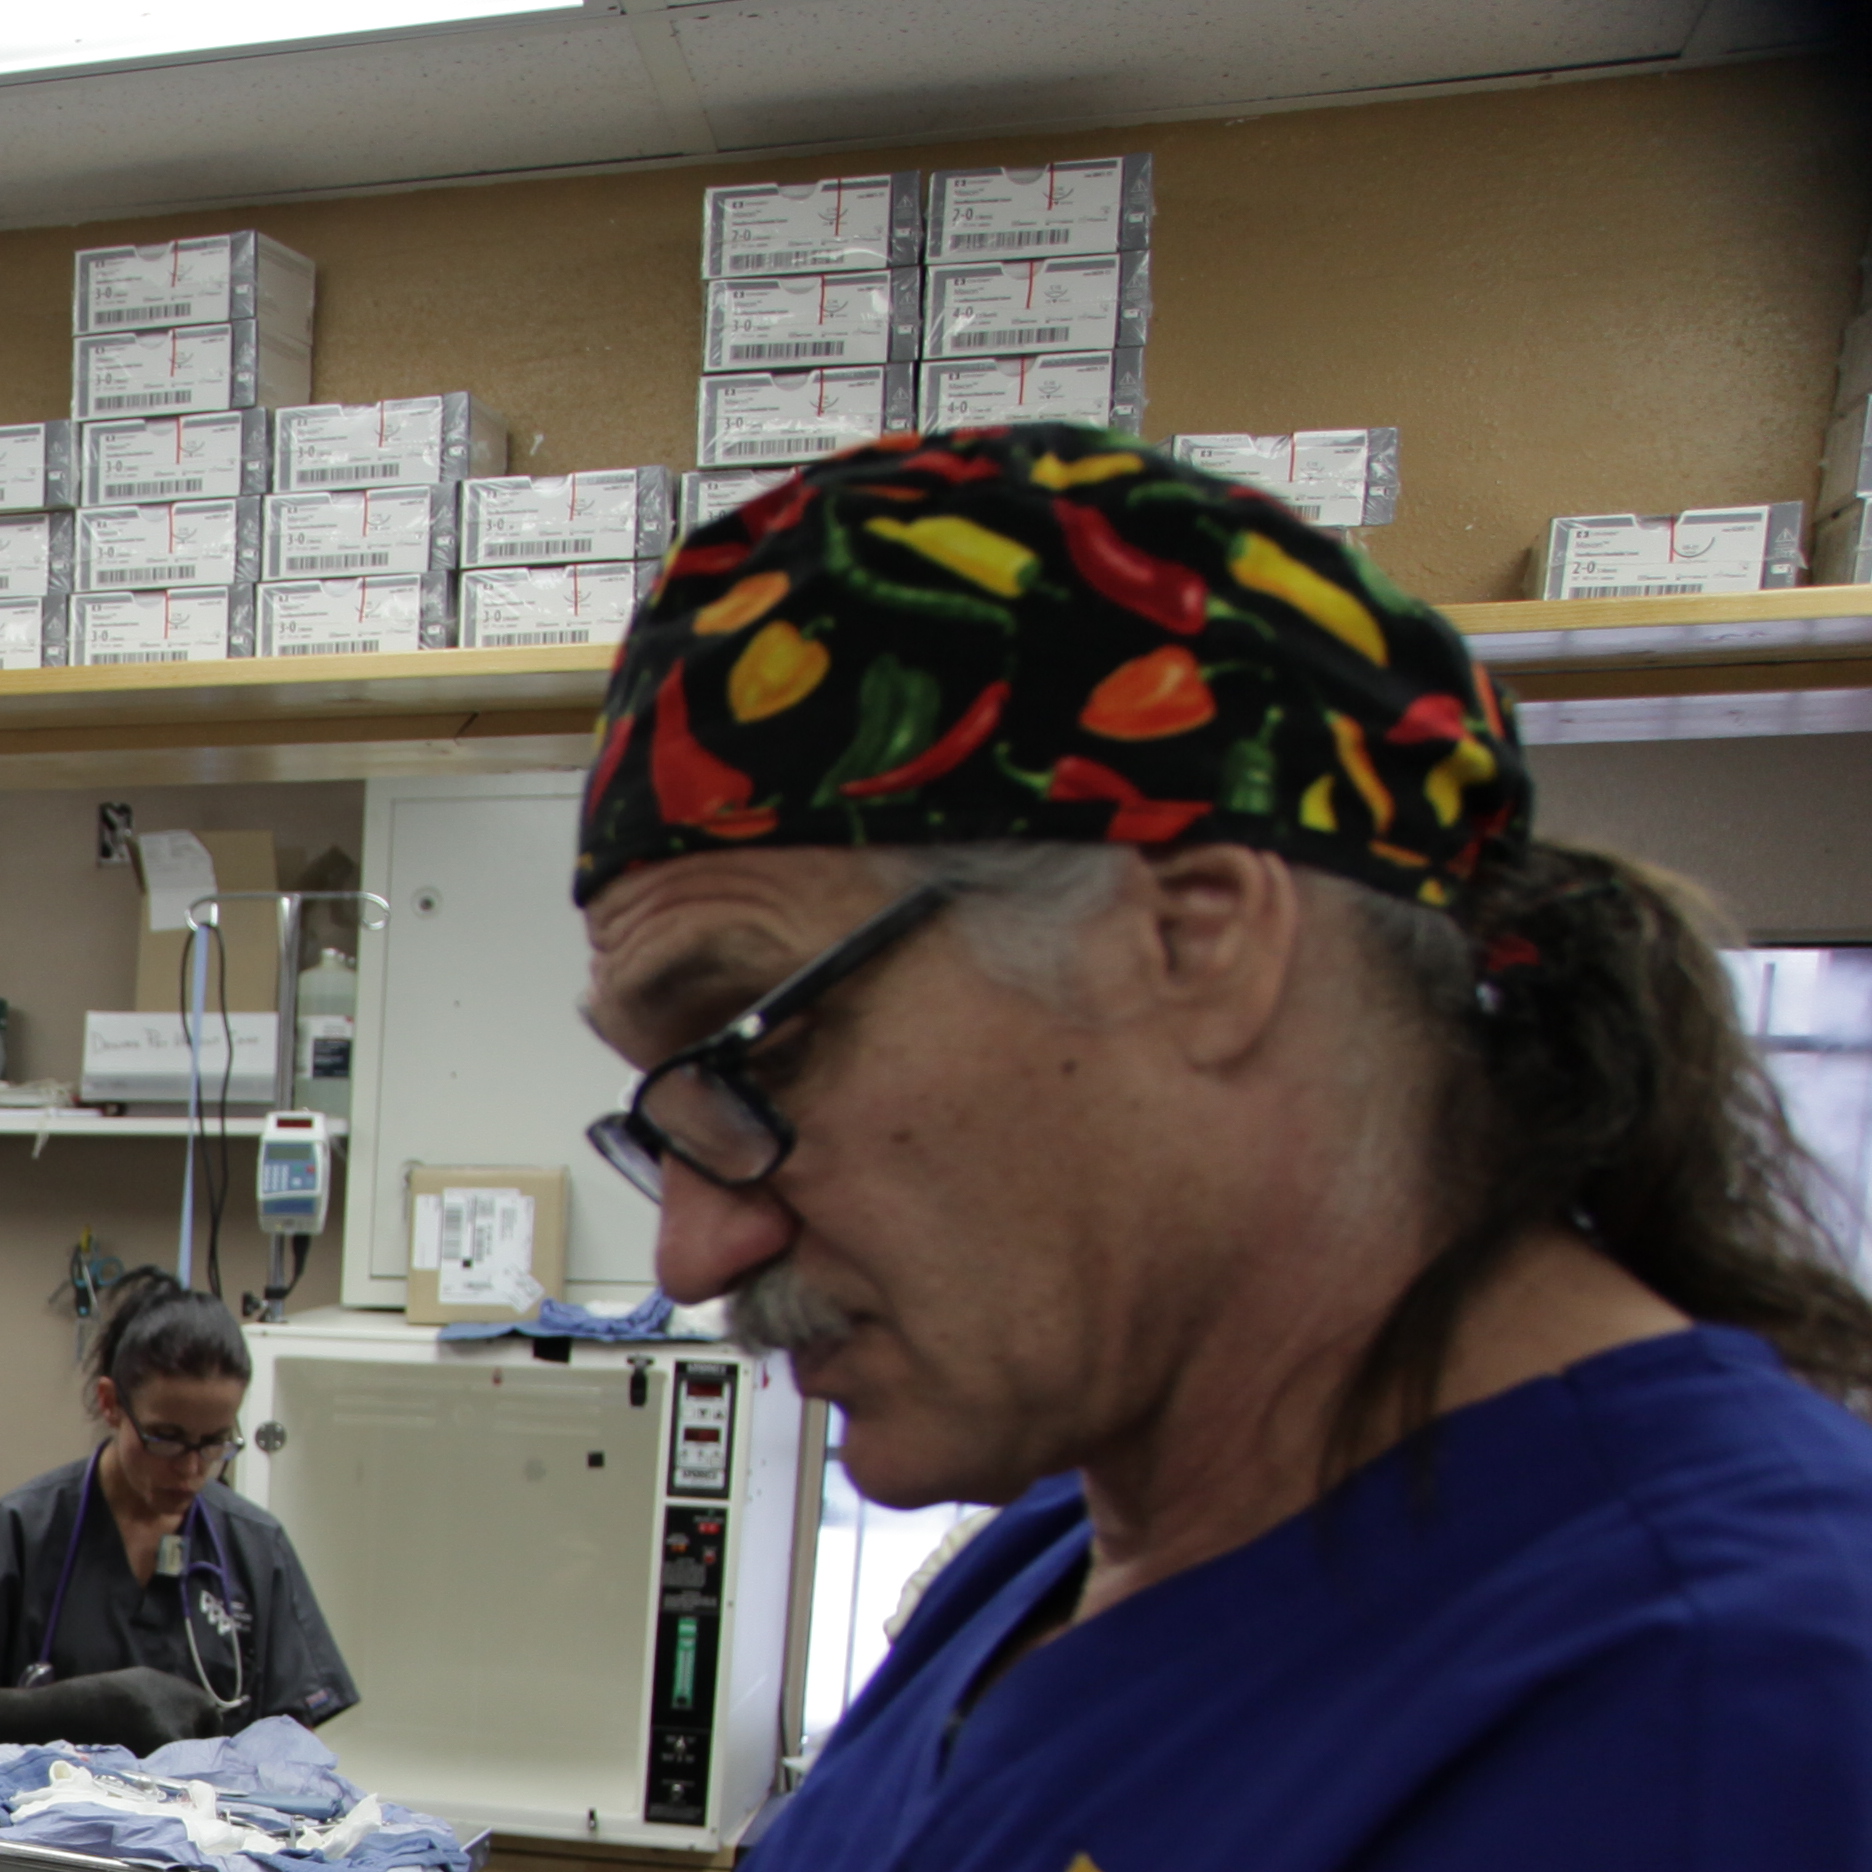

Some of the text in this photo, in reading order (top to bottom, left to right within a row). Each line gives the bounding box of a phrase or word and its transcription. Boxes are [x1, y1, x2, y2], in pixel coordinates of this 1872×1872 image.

[95, 286, 113, 300] 3-0
[732, 319, 753, 333] 3-0
[95, 372, 113, 386] 3-0
[948, 401, 968, 413] 4-0
[724, 416, 744, 430] 3-0
[105, 460, 123, 474] 3-0
[486, 518, 505, 532] 3-0
[287, 532, 306, 546] 3-0
[97, 546, 115, 559] 3-0
[1572, 561, 1596, 574] 2-0
[483, 609, 502, 623] 3-0
[279, 620, 297, 634] 3-0
[91, 629, 109, 643] 3-0
